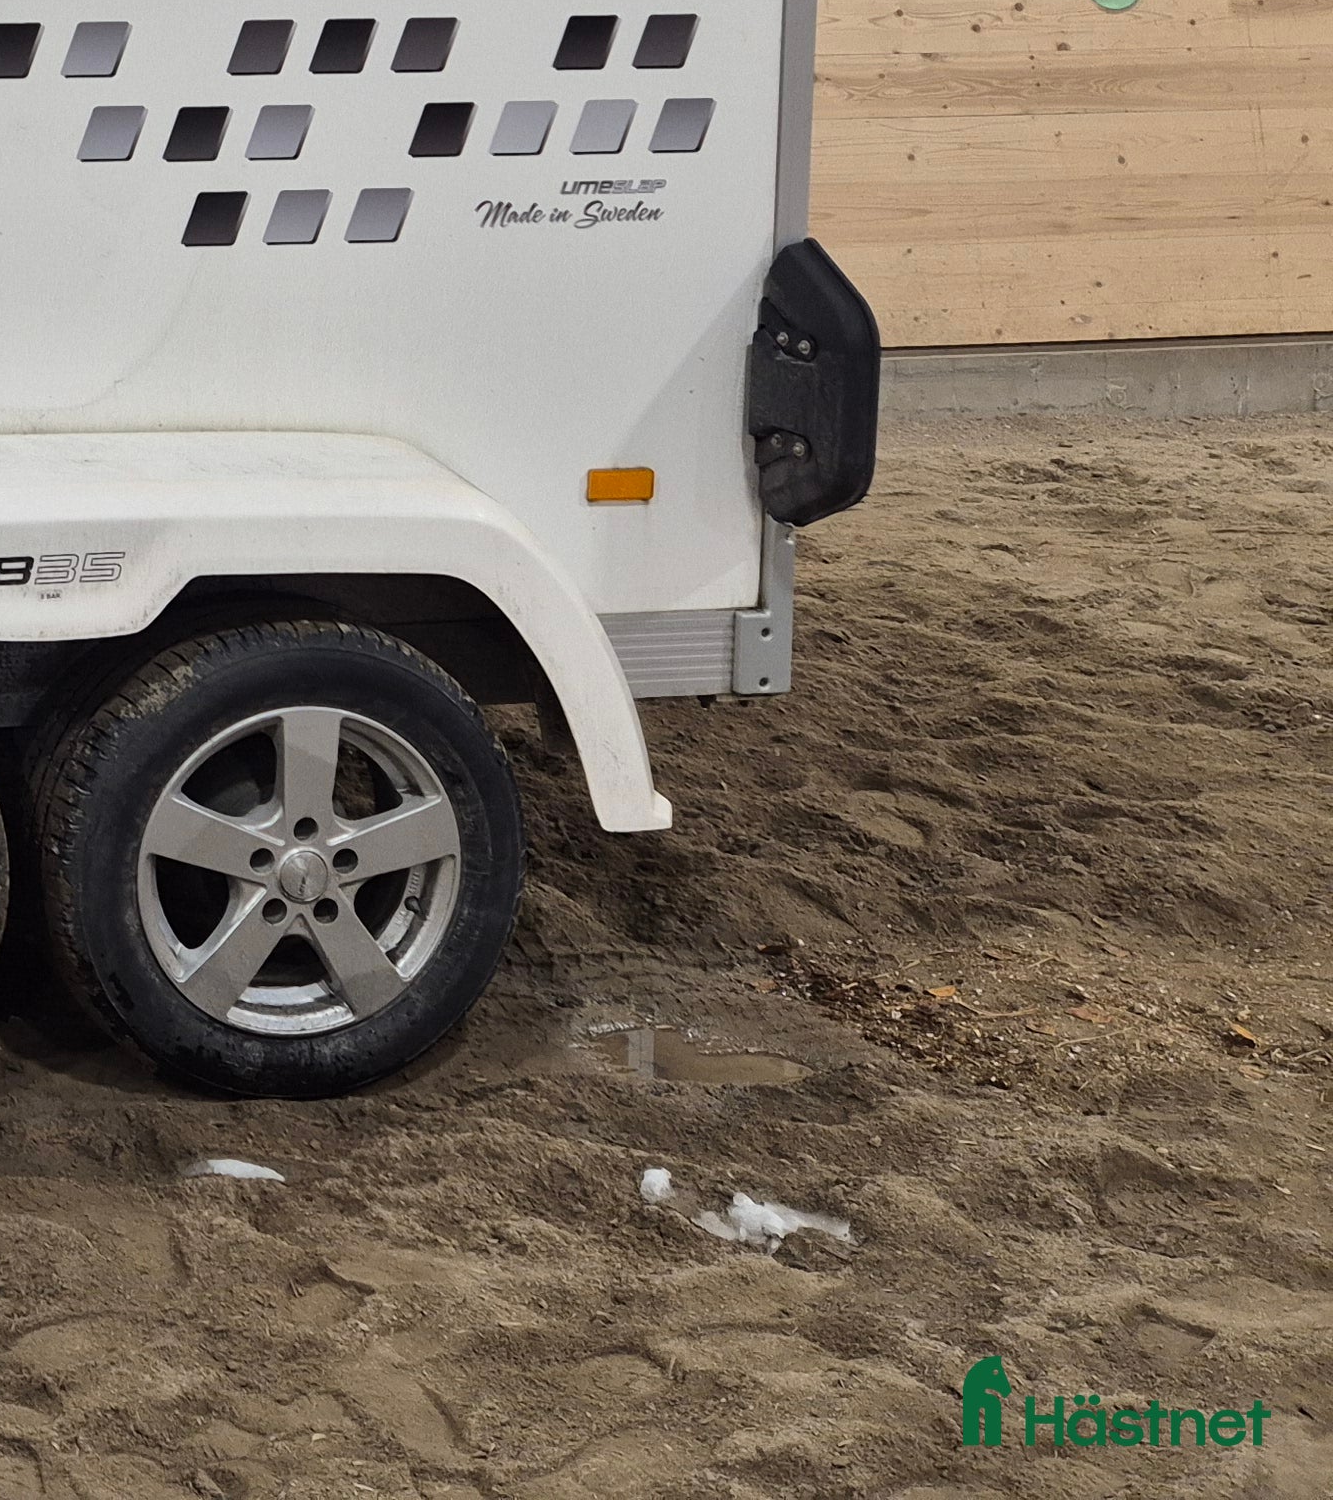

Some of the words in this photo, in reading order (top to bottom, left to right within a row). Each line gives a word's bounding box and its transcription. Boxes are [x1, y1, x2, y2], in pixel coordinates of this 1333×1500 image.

[474, 200, 545, 228] Made
[549, 207, 573, 222] in
[573, 199, 665, 229] Sweden
